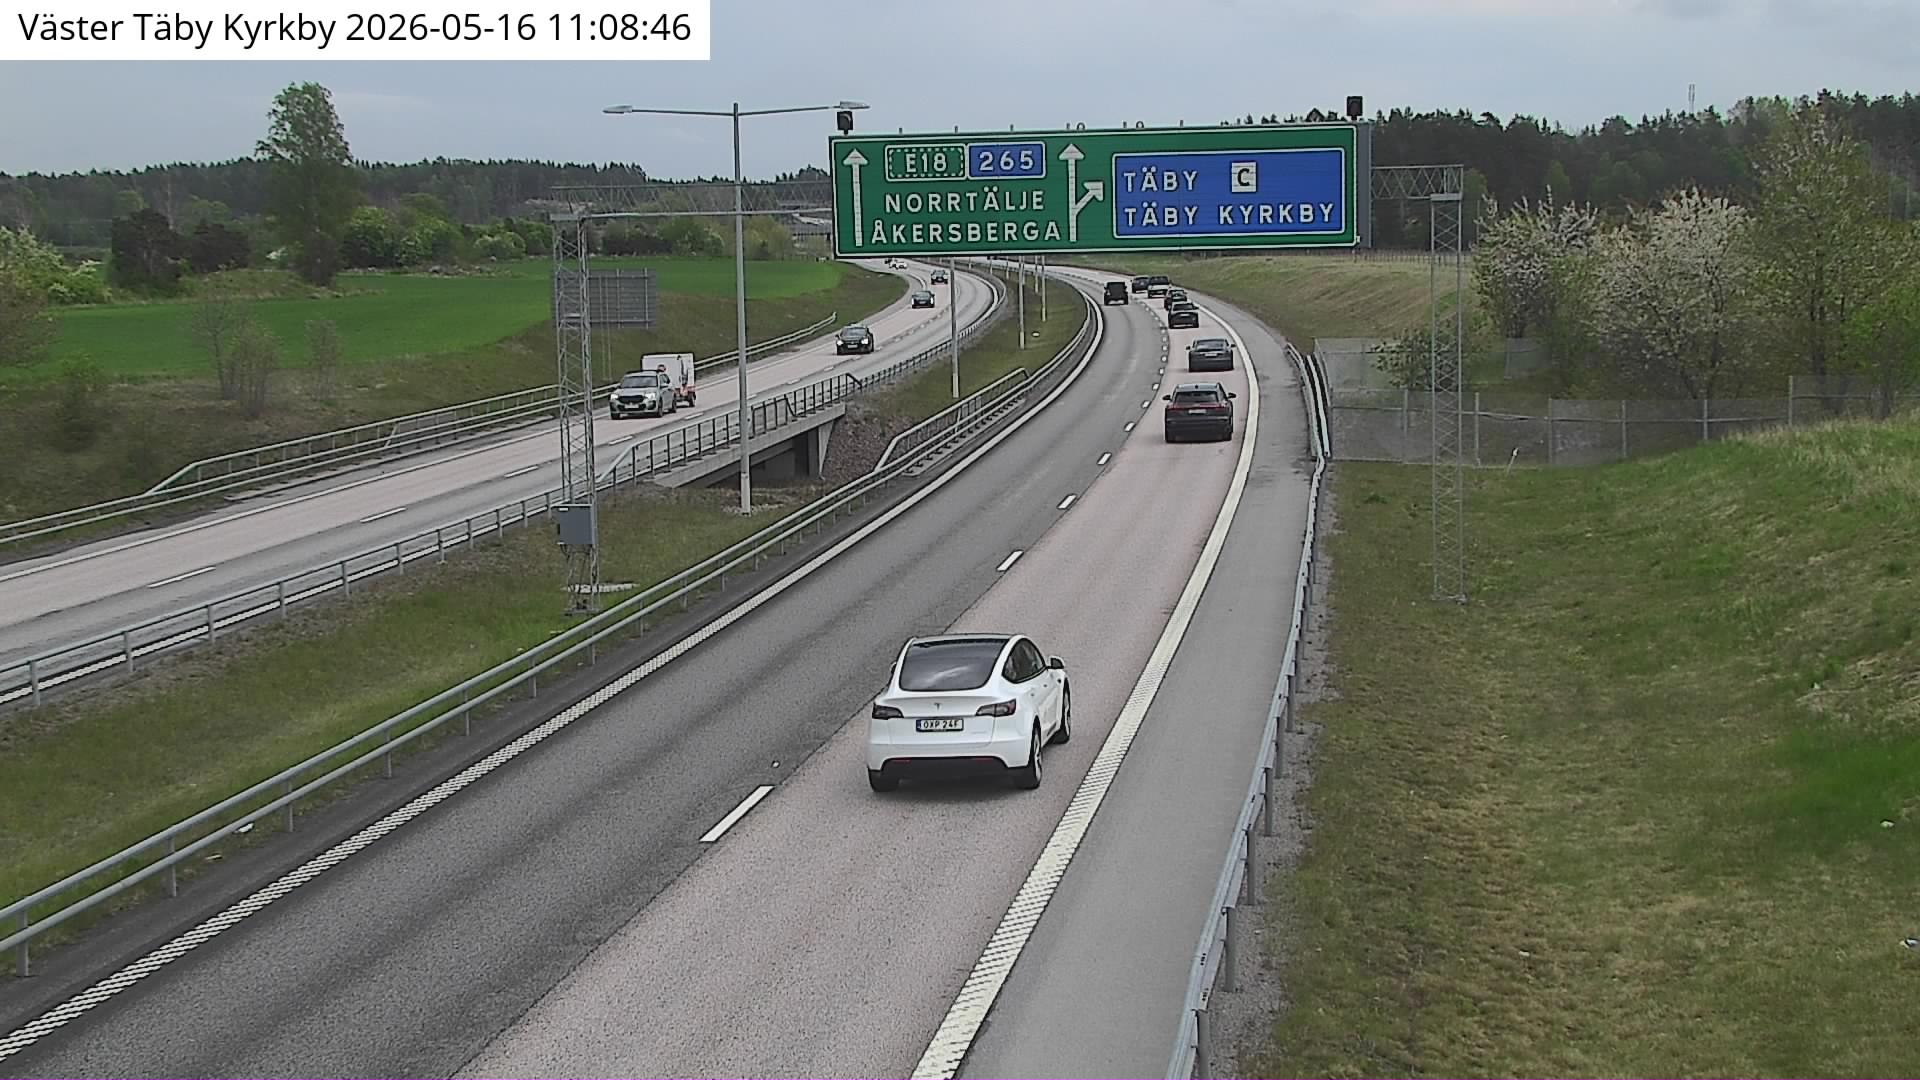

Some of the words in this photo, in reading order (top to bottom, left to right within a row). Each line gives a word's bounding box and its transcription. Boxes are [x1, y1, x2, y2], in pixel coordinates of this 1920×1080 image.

[905, 153, 947, 173] E18
[979, 150, 1034, 171] 265
[1123, 165, 1198, 192] TÄBY
[1237, 168, 1251, 187] C
[885, 186, 1045, 214] NORRTÄLJE
[1124, 200, 1198, 227] TÄBY
[1218, 203, 1335, 226] KYRKBY
[871, 217, 1062, 244] ÅKERSBERGA
